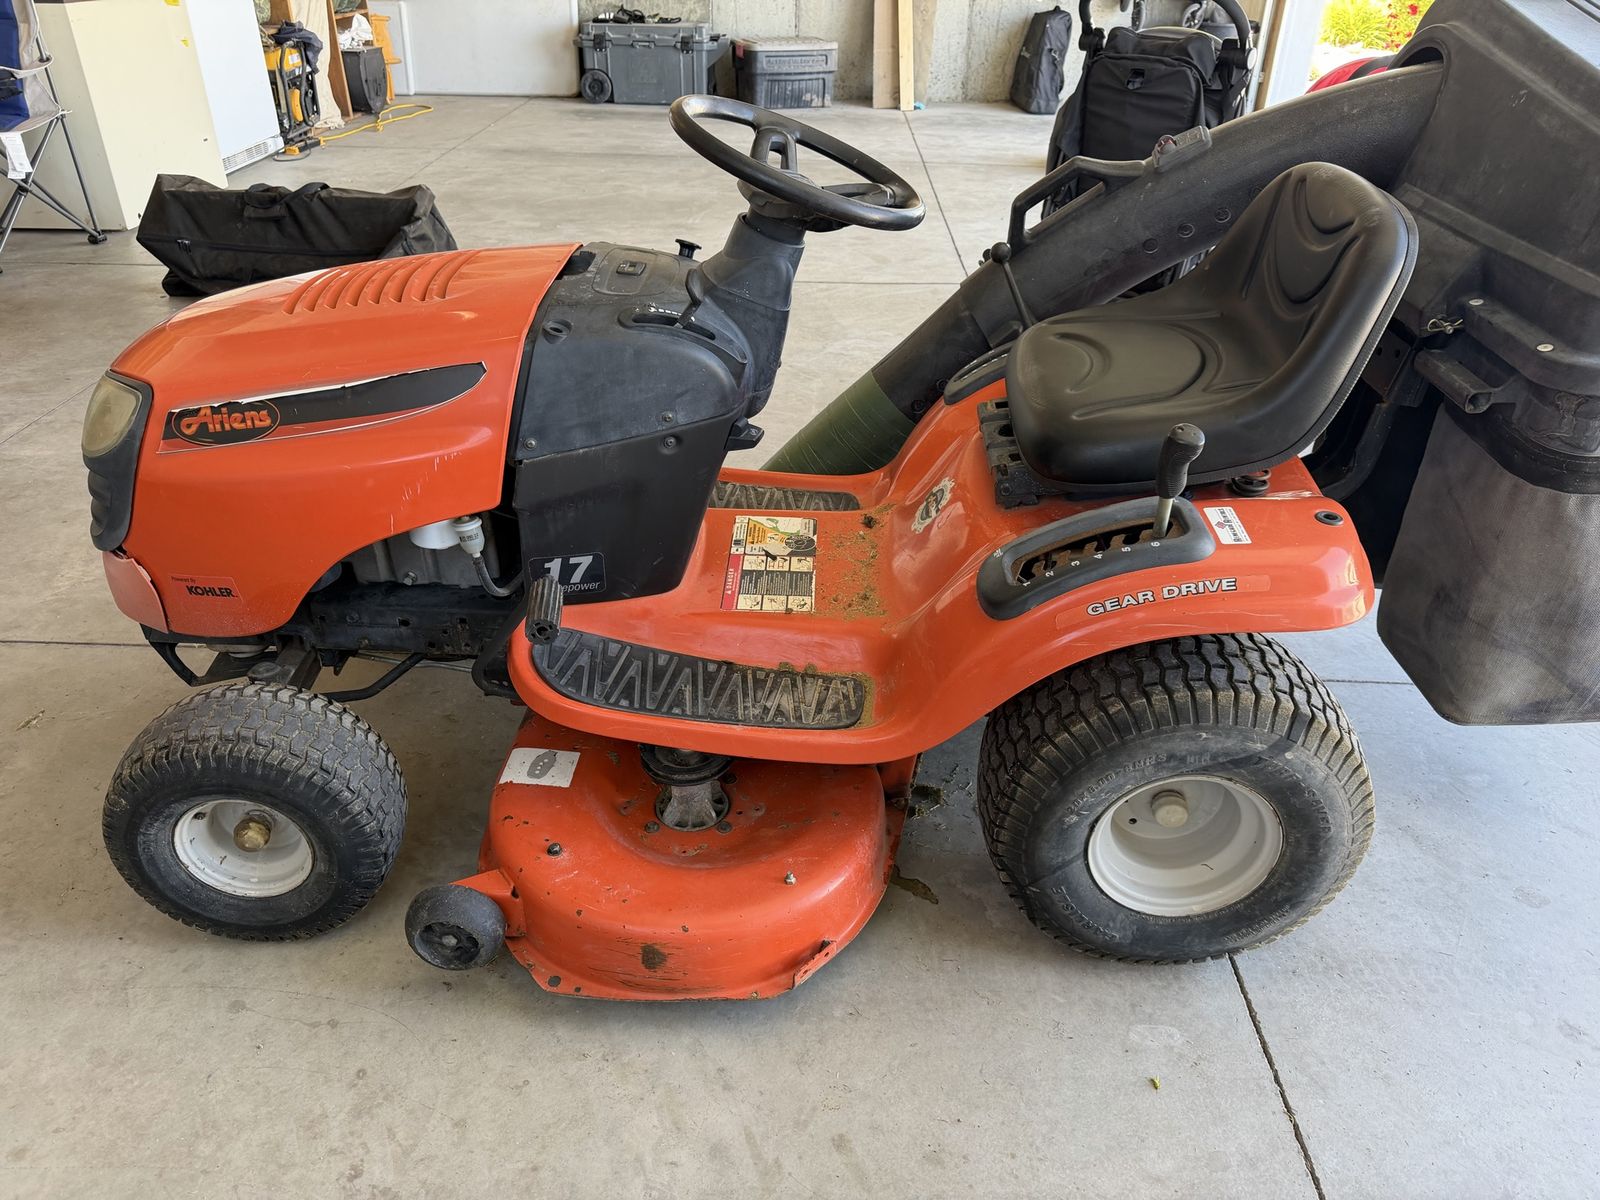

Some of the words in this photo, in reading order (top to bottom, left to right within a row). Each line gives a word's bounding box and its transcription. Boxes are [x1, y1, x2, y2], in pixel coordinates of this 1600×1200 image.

[181, 406, 272, 435] Ariens
[544, 555, 593, 583] 17
[186, 585, 234, 598] KOHLER
[1086, 590, 1155, 616] GEAR
[1162, 578, 1238, 599] DRIVE
